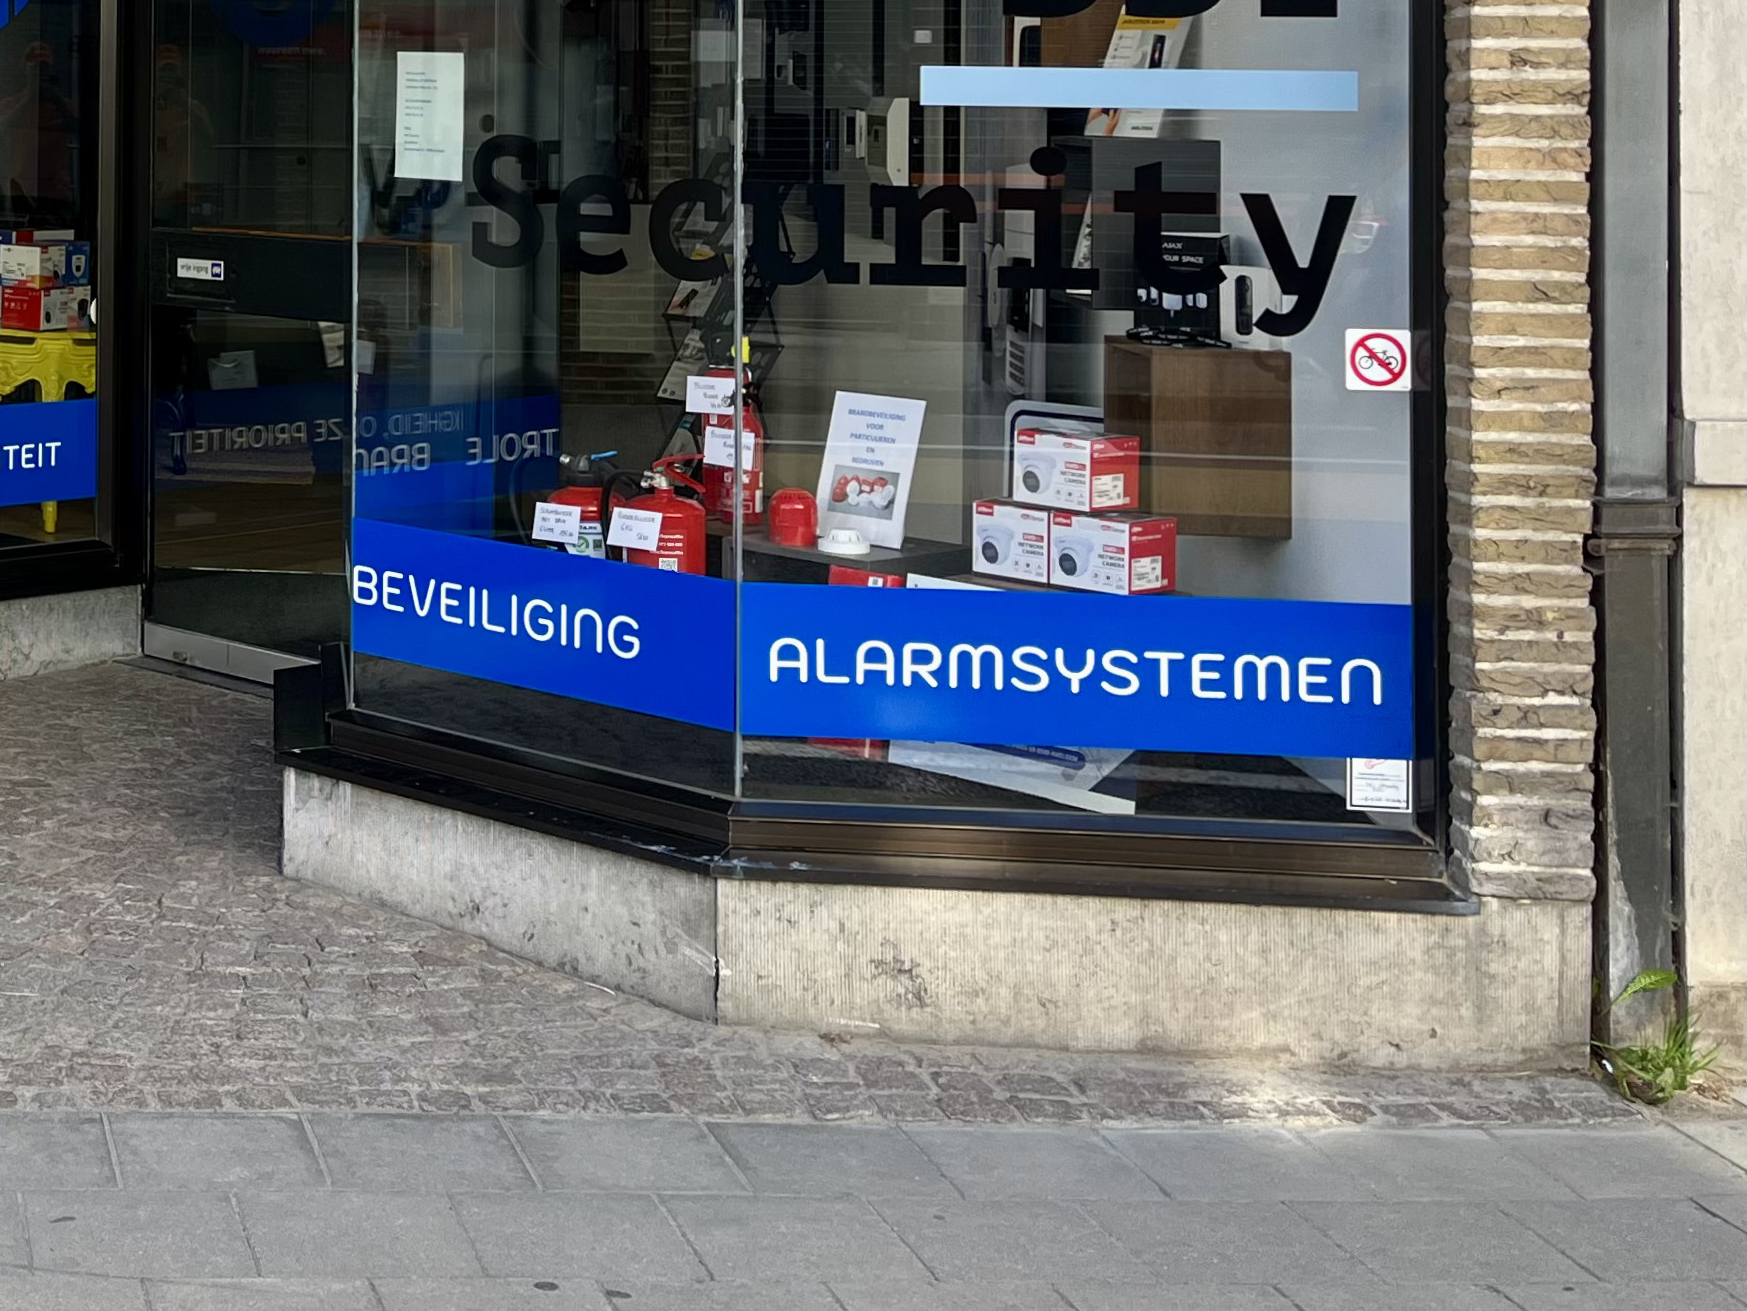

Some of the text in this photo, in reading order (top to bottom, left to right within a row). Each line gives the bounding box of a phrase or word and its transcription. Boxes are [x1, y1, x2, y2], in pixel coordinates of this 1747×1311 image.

[470, 134, 1357, 337] Security
[353, 565, 641, 660] BEVEILIGING
[768, 637, 1383, 706] ALARMSYSTEMEN
